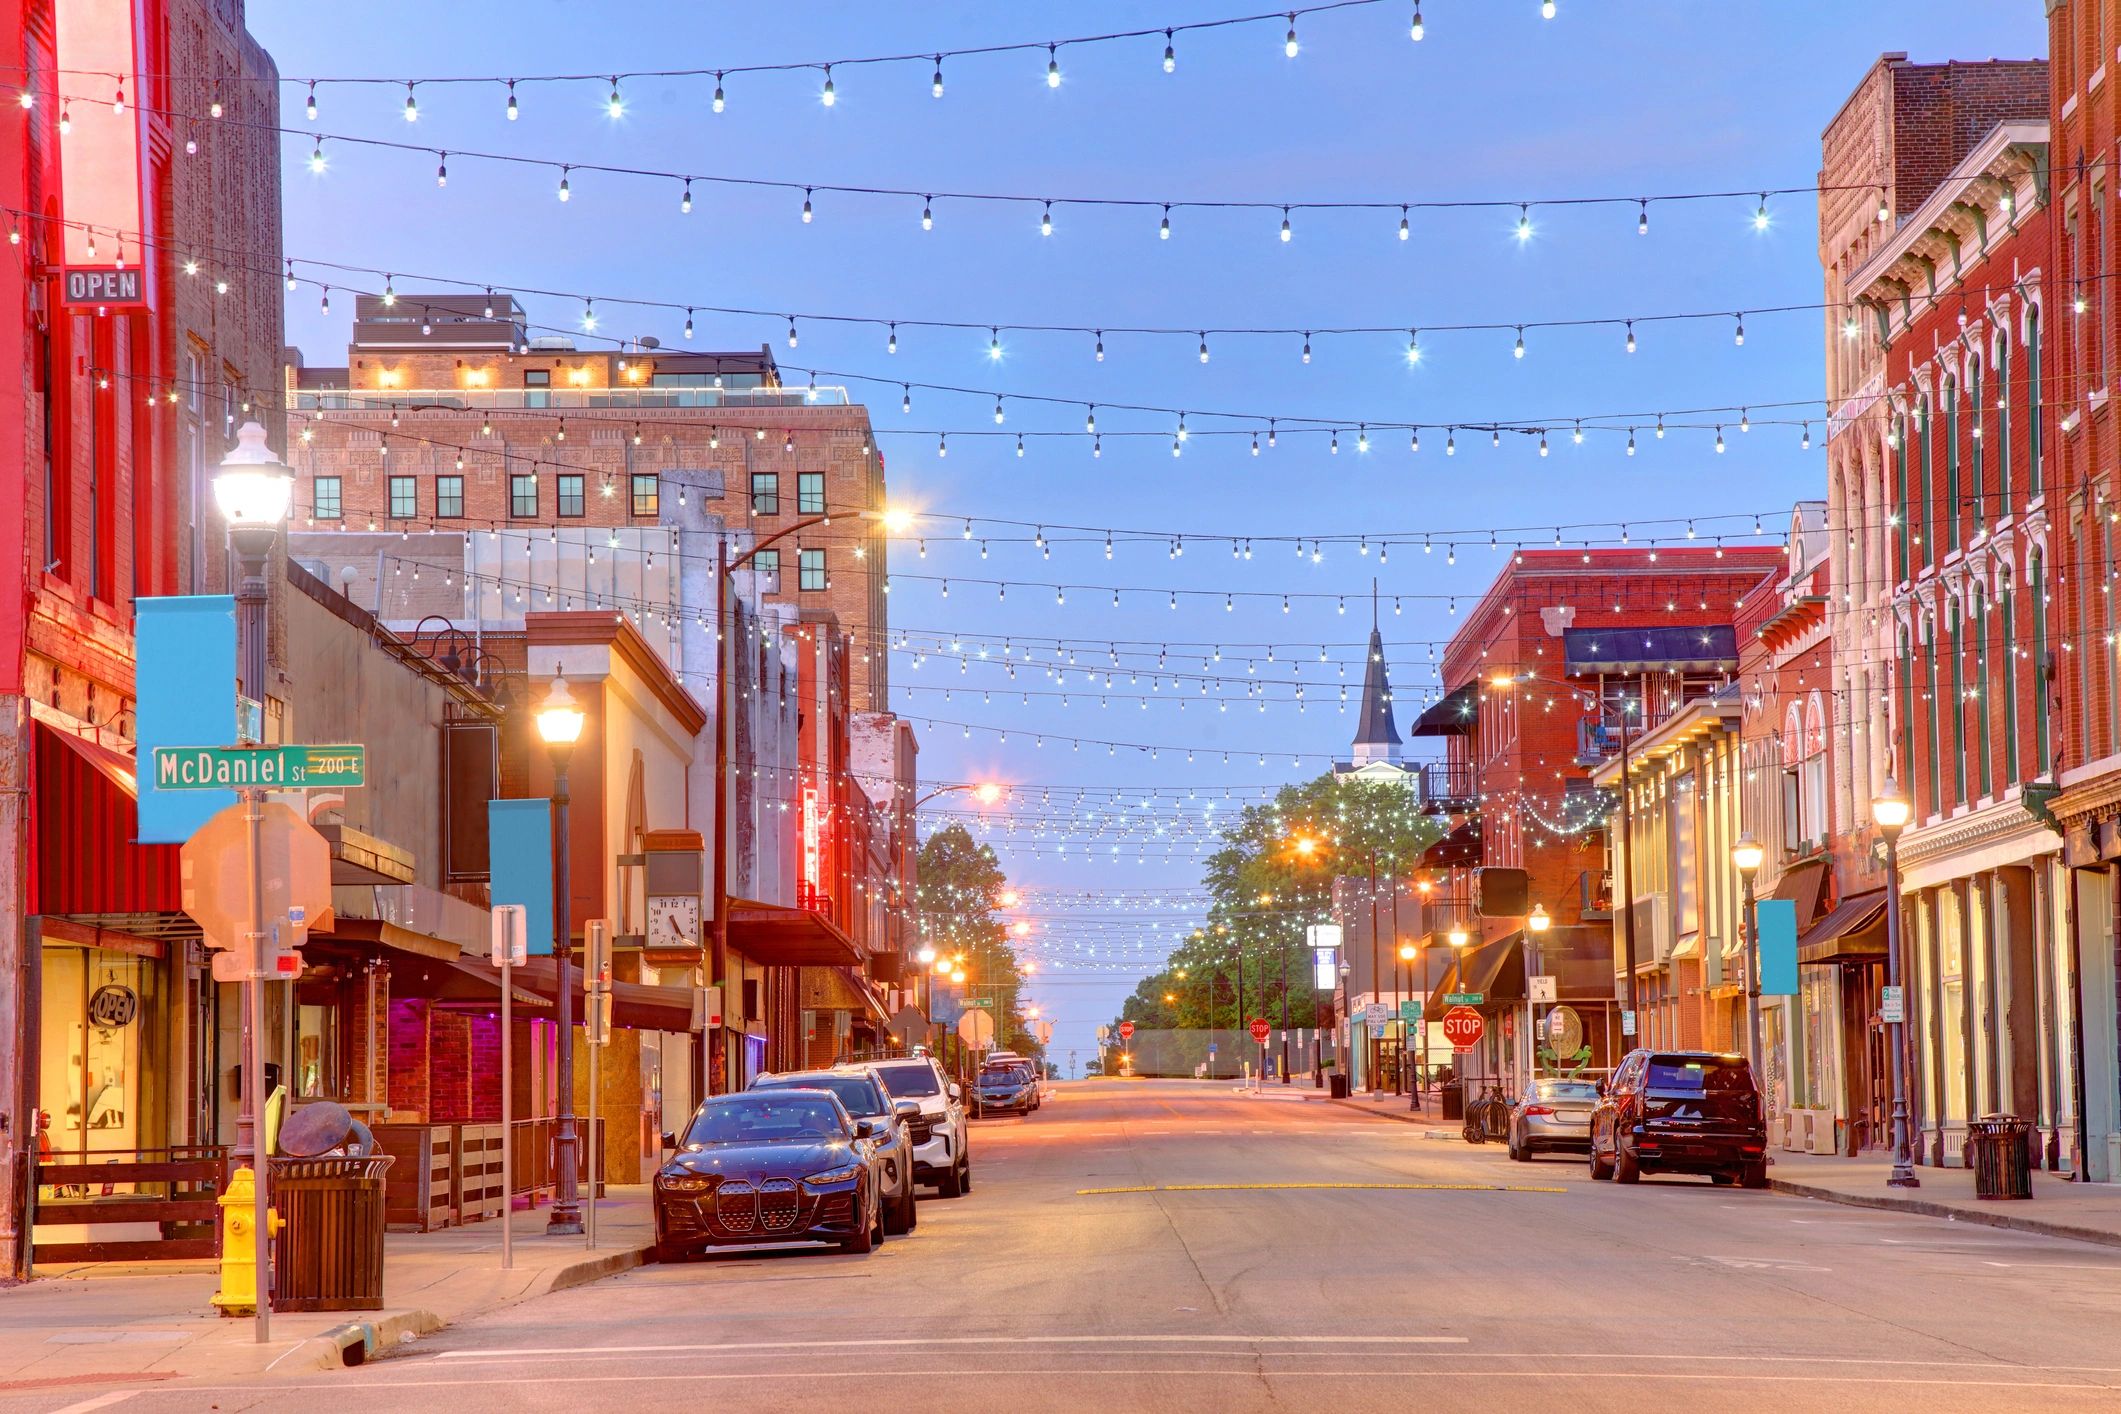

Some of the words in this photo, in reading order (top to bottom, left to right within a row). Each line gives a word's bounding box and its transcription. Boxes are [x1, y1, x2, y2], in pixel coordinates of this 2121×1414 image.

[70, 272, 136, 298] OPEN
[160, 751, 284, 784] McDaniel
[292, 765, 306, 781] St
[318, 757, 344, 774] 200
[351, 757, 359, 774] E
[1444, 995, 1464, 1003] Walnut
[1884, 989, 1888, 998] 2
[97, 991, 135, 1024] OPEN
[1446, 1019, 1481, 1034] STOP
